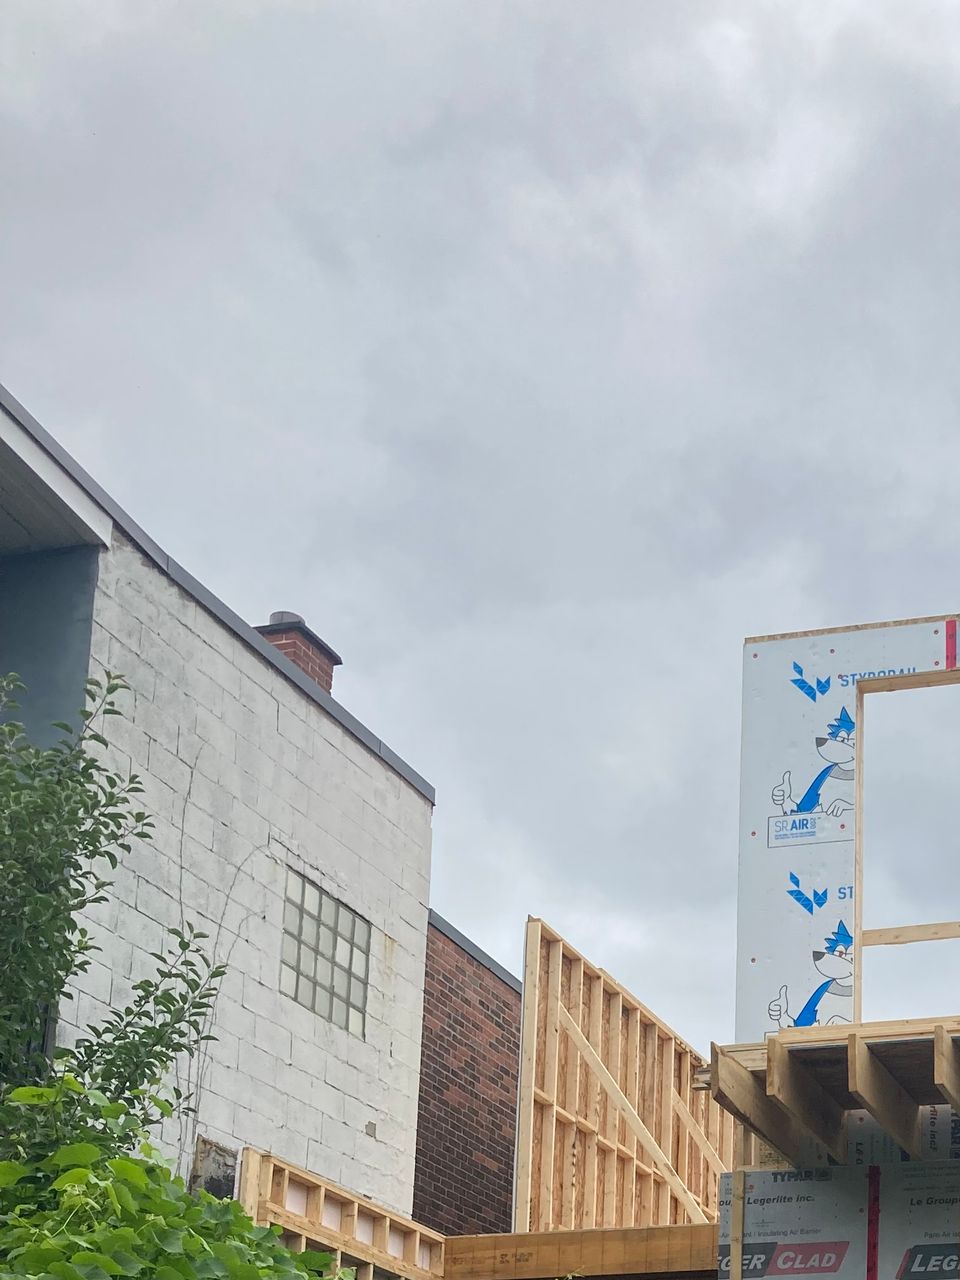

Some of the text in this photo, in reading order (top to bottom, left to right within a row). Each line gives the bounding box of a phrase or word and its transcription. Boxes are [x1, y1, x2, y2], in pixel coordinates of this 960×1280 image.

[774, 818, 809, 832] SR AIR
[747, 1195, 794, 1207] Legerlite
[926, 1196, 960, 1207] Group
[776, 1251, 837, 1270] CLAD
